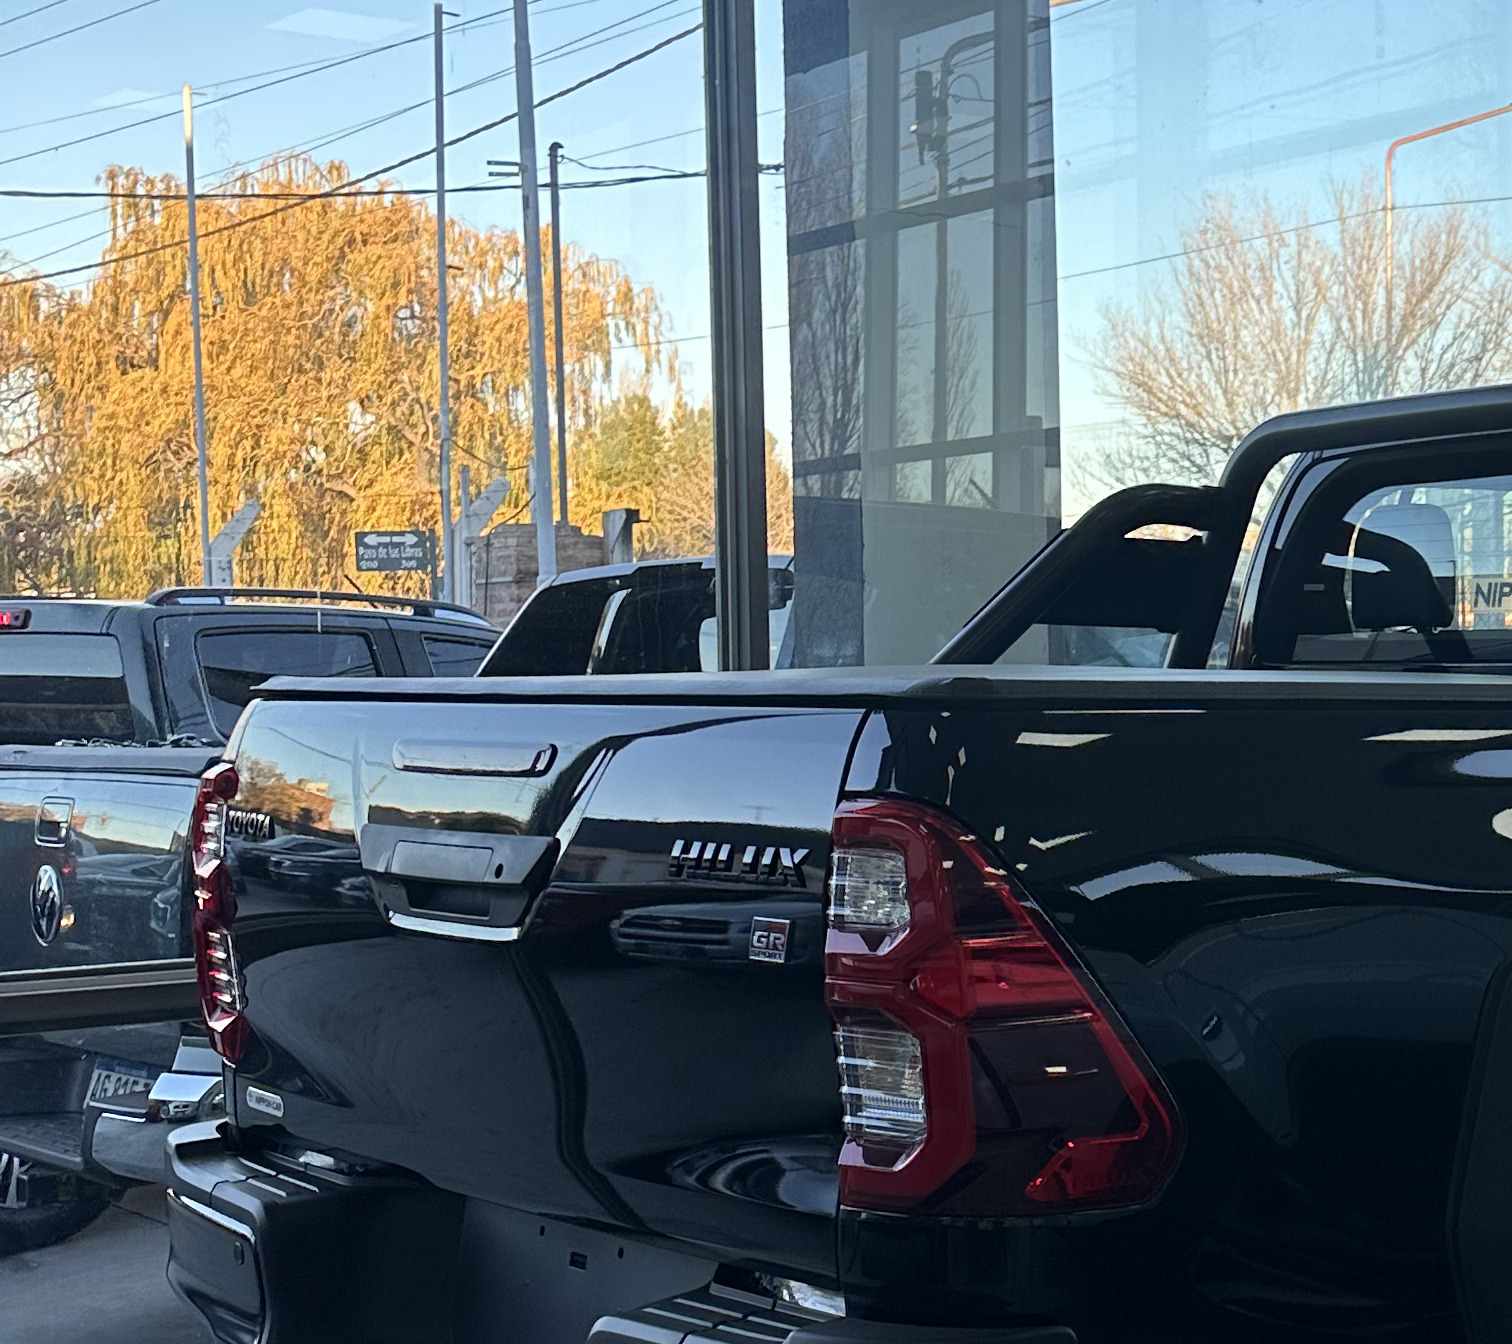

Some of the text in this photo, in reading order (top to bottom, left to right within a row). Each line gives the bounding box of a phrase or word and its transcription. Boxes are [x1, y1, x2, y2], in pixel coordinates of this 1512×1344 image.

[227, 810, 272, 840] TOYOTA
[668, 839, 811, 888] HILUX
[752, 931, 786, 951] GR
